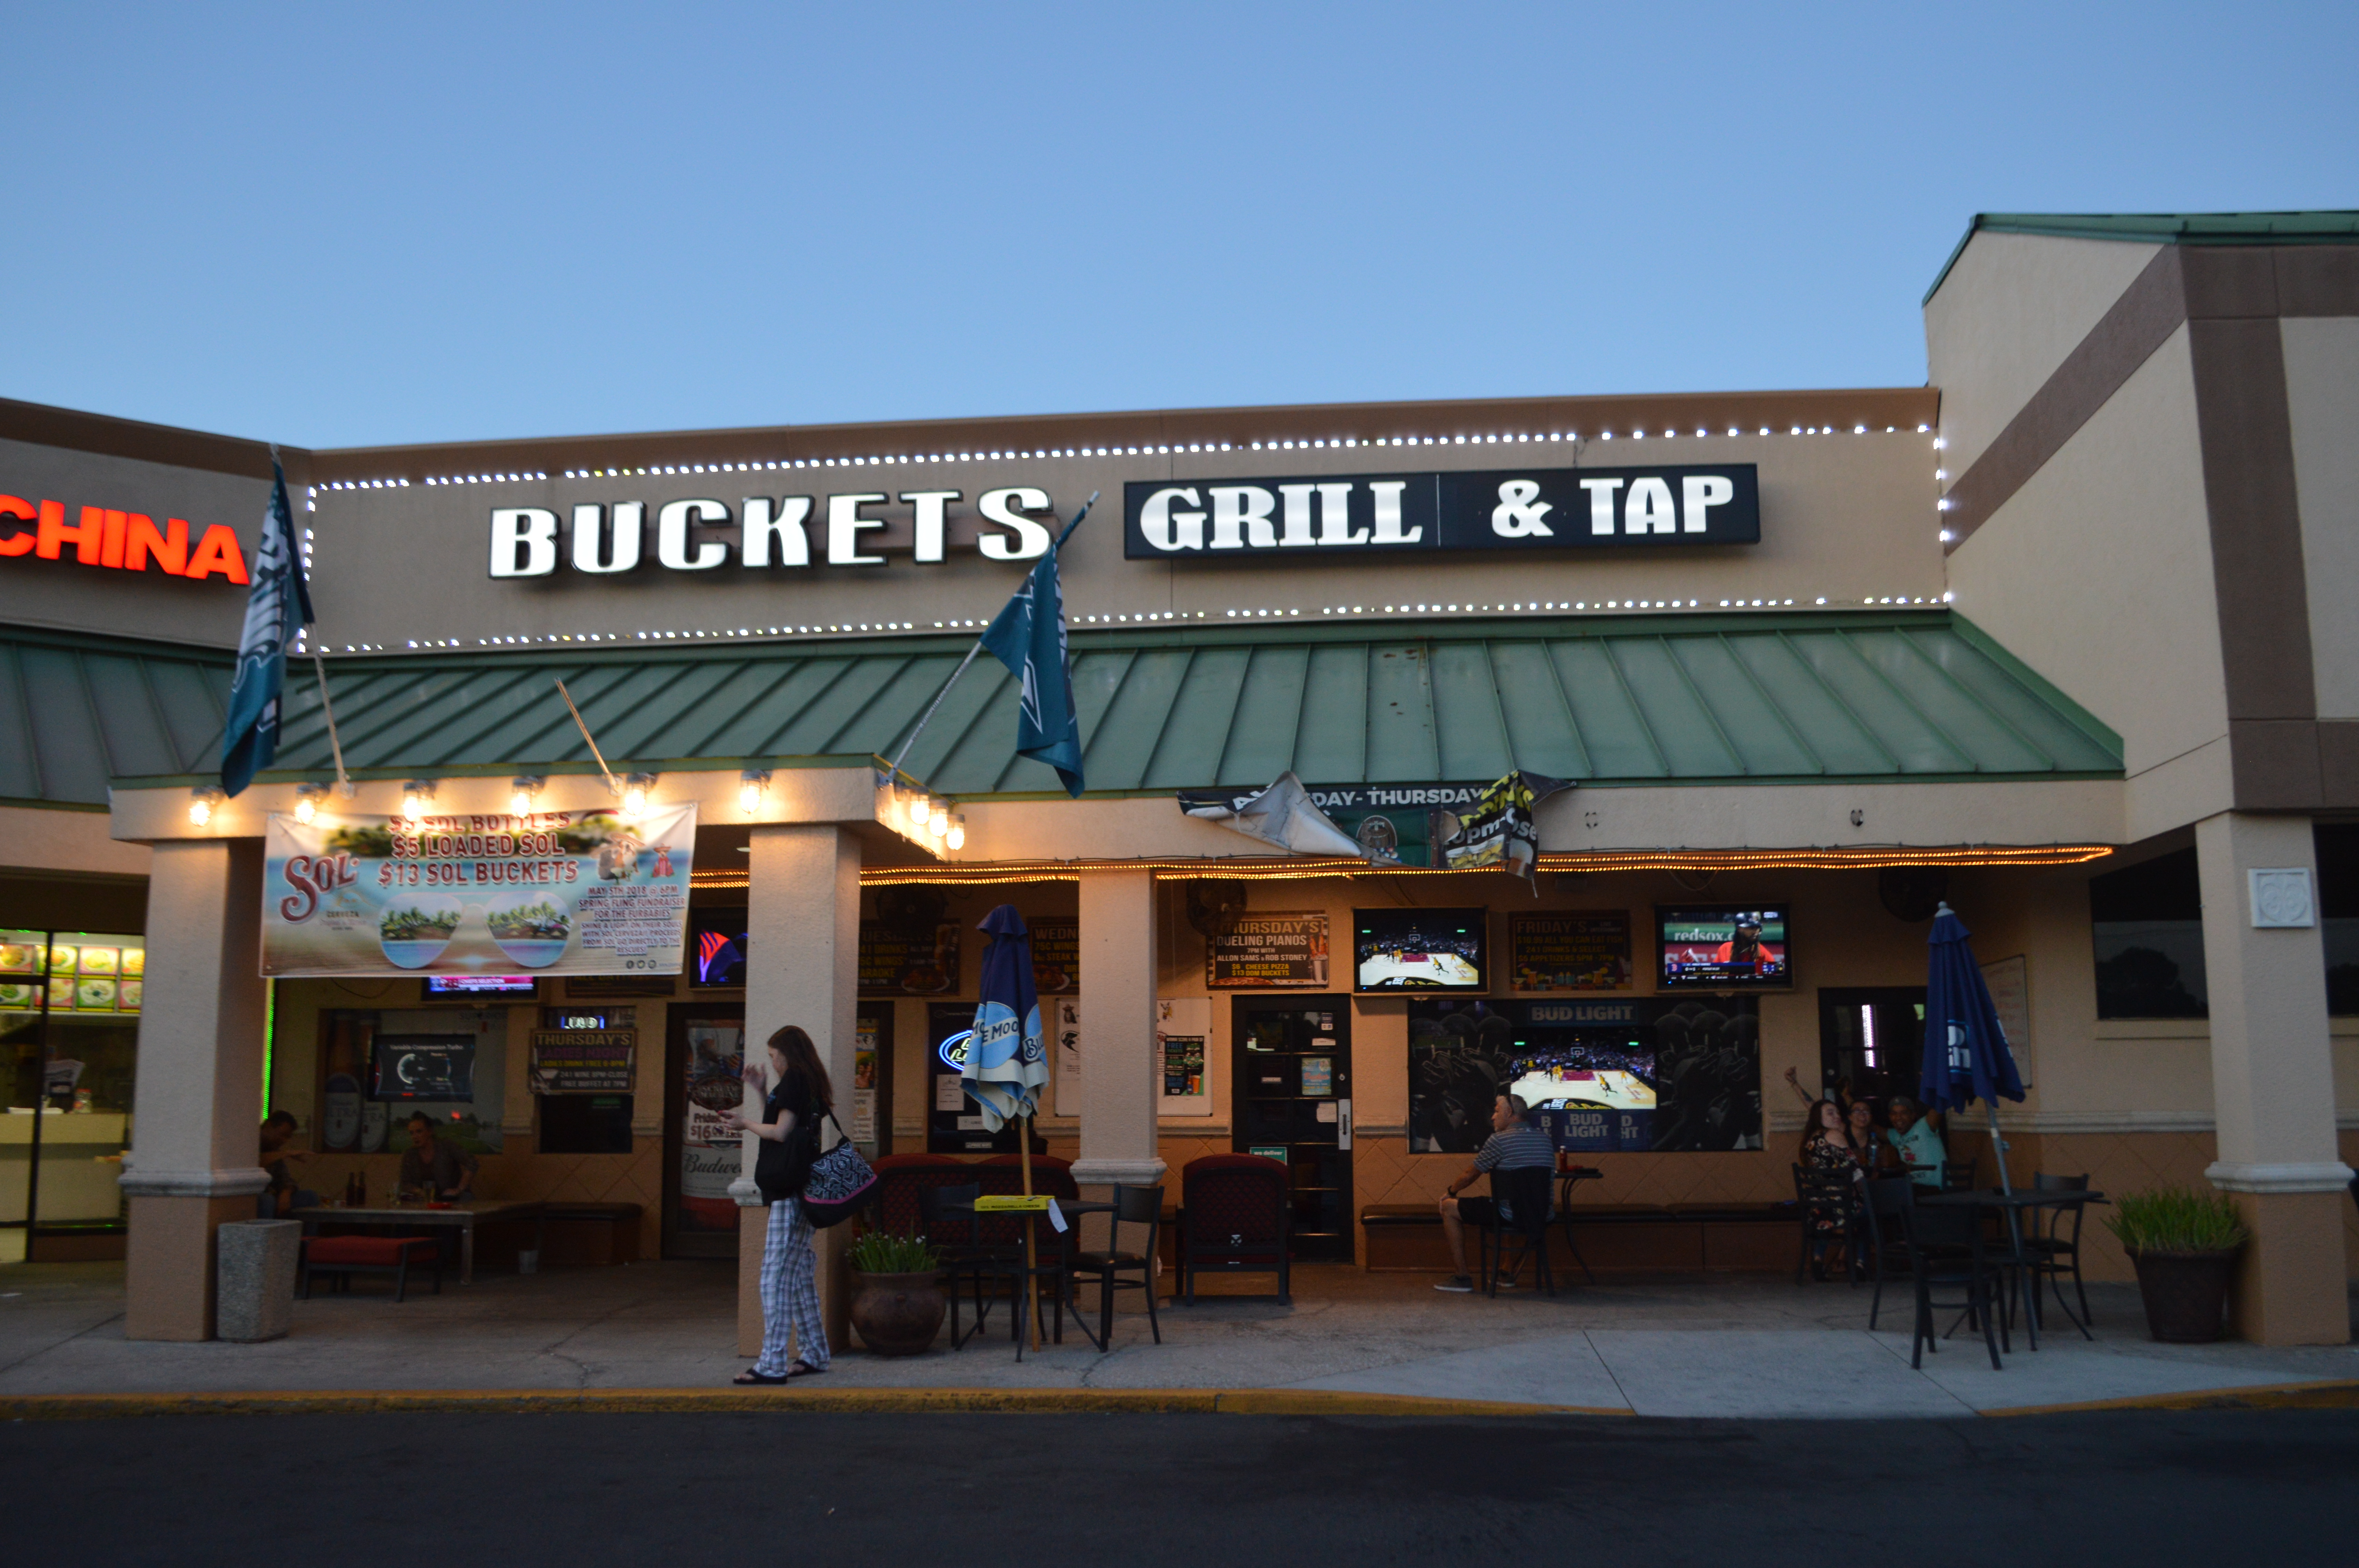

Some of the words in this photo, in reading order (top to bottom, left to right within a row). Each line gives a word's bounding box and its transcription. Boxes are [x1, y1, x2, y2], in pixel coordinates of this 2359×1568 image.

[1140, 482, 1422, 551] GRILL
[1492, 480, 1554, 538] &
[1580, 475, 1734, 535] TAP
[0, 495, 250, 584] CHINA
[489, 487, 1053, 579] BUCKETS
[423, 815, 465, 832] SOL
[471, 811, 571, 832] BOTTLES
[391, 833, 420, 860] $5
[425, 834, 514, 858] LOADED
[519, 833, 565, 856] SOL
[378, 861, 420, 887] $13
[426, 863, 468, 885] SOL
[475, 860, 578, 884] BUCKETS
[588, 886, 607, 897] MAY
[609, 886, 625, 897] 5TH
[627, 885, 647, 897] 2018
[660, 884, 678, 896] 6PM
[579, 898, 609, 910] SPRING
[612, 898, 635, 909] FLING
[636, 897, 685, 908] FUNDRAISER
[594, 909, 610, 920] FOR
[612, 909, 626, 920] THE
[629, 908, 671, 920] FURBABIES
[1517, 921, 1587, 933] FRIDAY'S
[1216, 935, 1263, 946] DUELING
[1266, 935, 1307, 946] PIANOS
[1532, 1007, 1573, 1021] BUD
[1576, 1005, 1633, 1021] LIGHT
[991, 1021, 1018, 1040] MOO
[537, 1034, 631, 1045] THURSDAY'S
[538, 1047, 583, 1058] LADIES
[586, 1047, 629, 1058] NIGHT
[1570, 1114, 1603, 1125] BUD
[1565, 1125, 1609, 1138] LIGHT
[683, 1154, 742, 1173] Budwe
